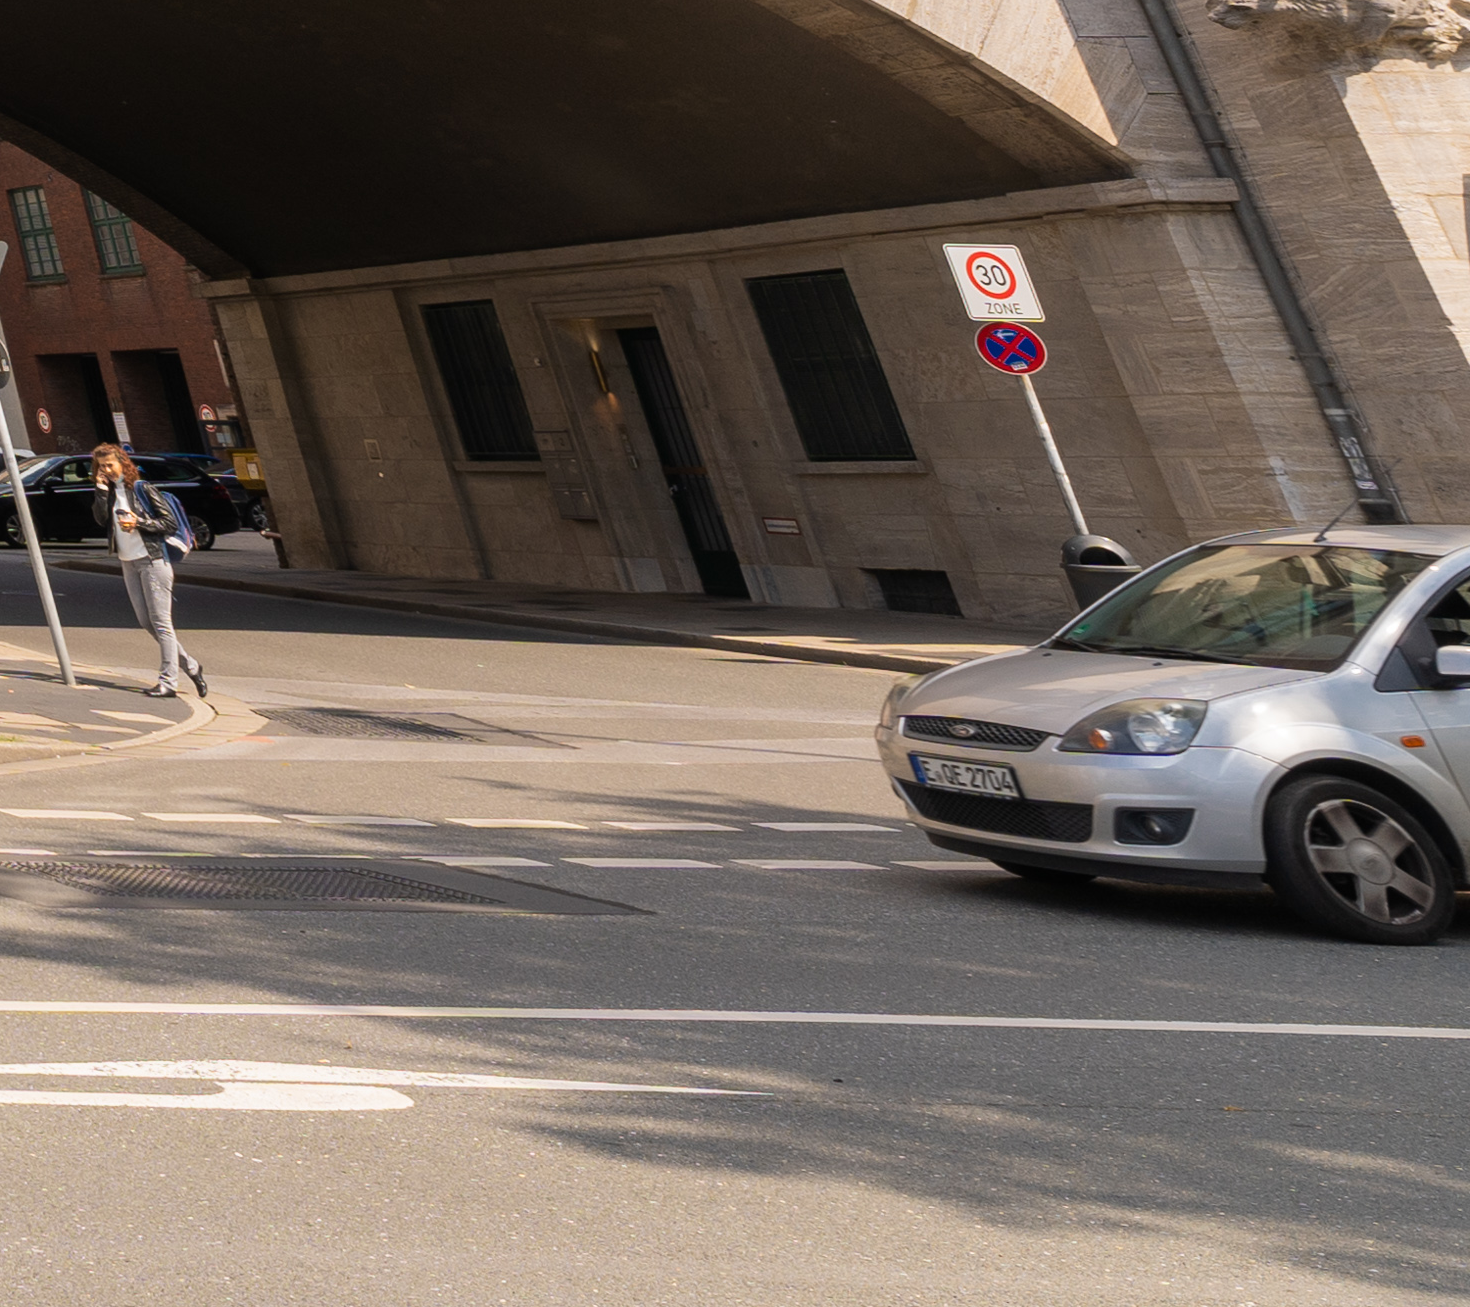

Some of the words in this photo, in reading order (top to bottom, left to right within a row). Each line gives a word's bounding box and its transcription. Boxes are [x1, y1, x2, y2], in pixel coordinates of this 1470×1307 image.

[975, 265, 1007, 286] 30
[985, 302, 1024, 315] ZONE
[920, 760, 936, 782] E
[966, 766, 1015, 793] 2704
